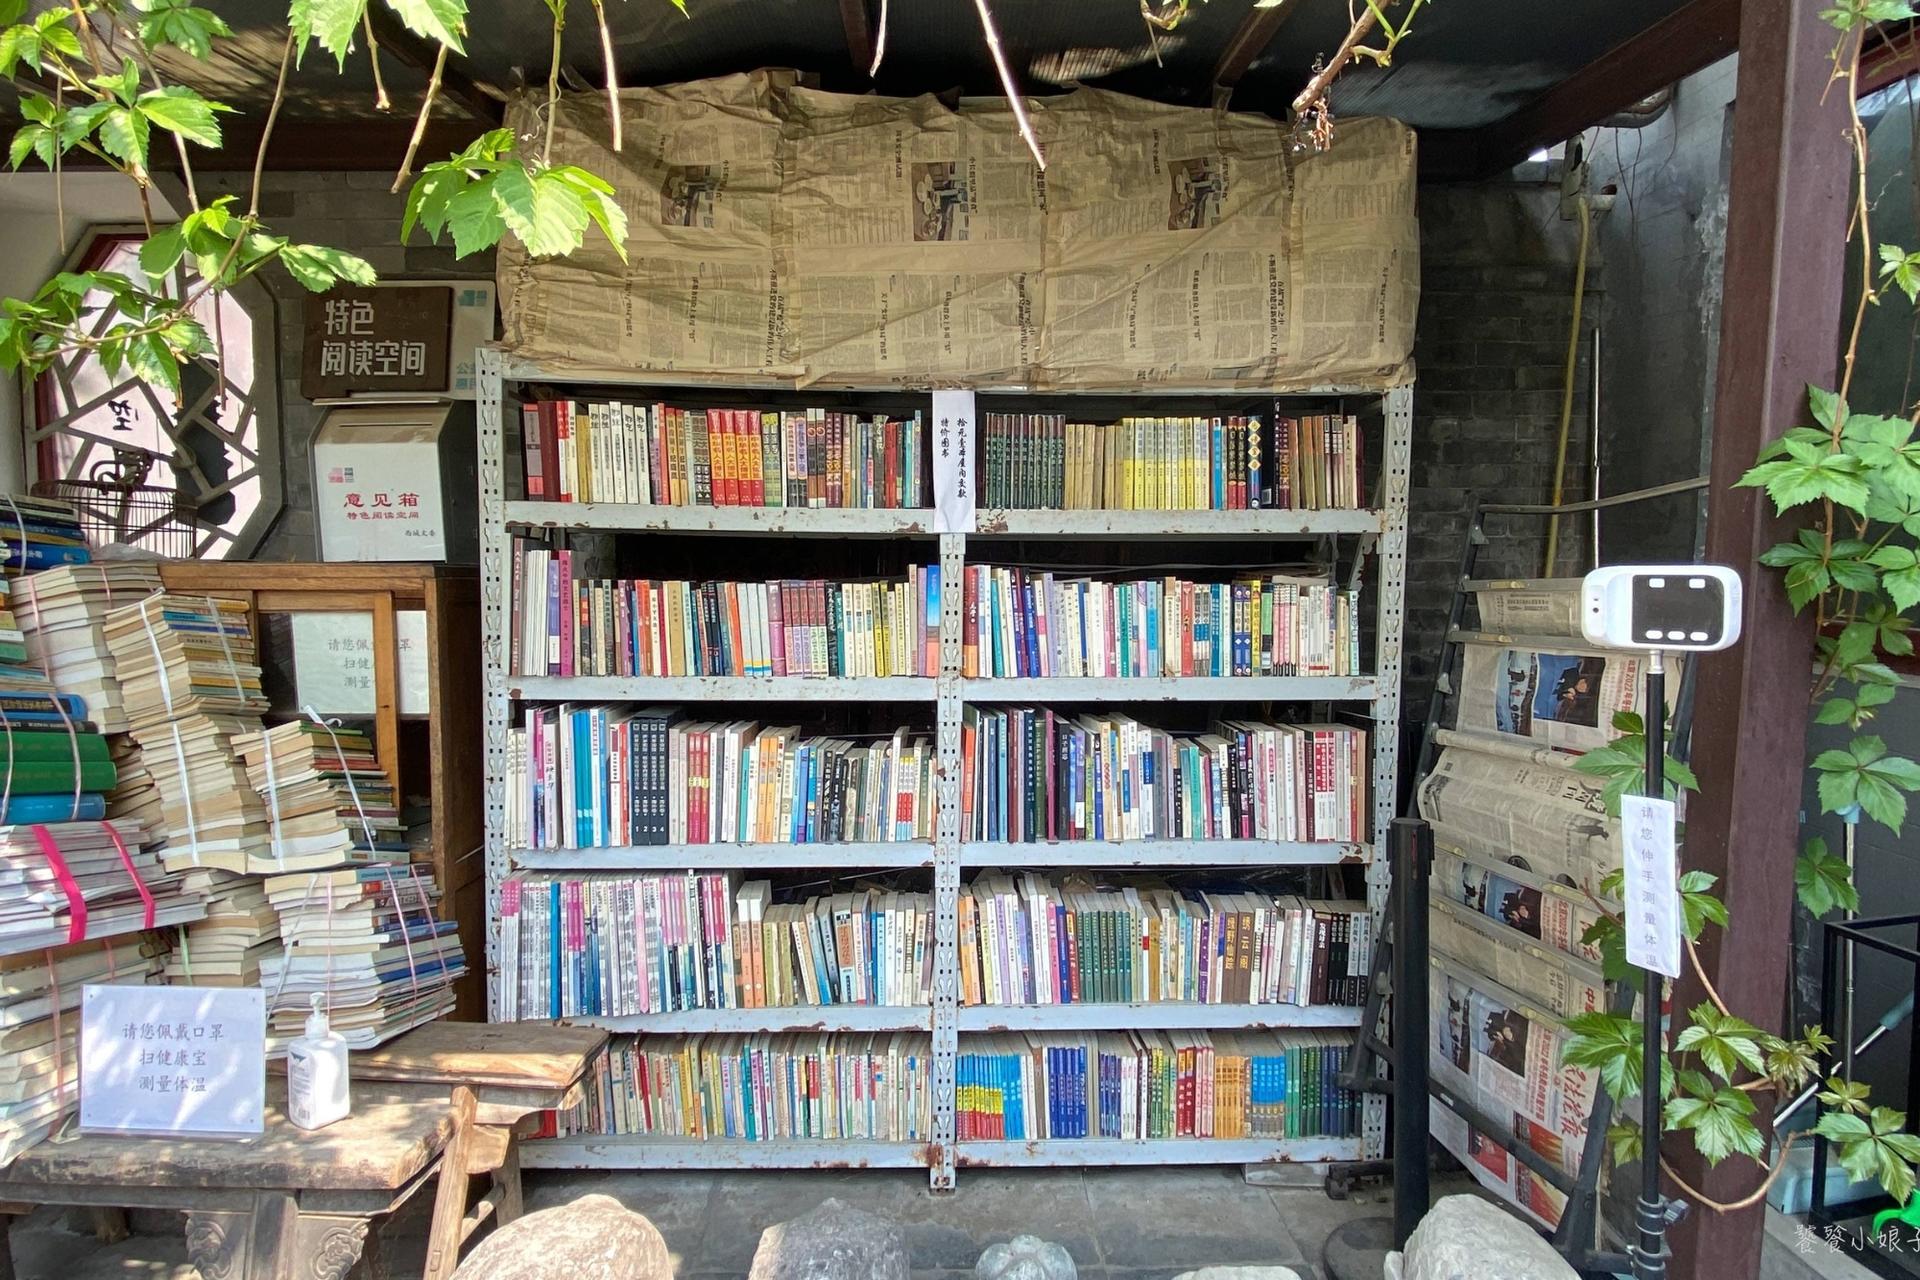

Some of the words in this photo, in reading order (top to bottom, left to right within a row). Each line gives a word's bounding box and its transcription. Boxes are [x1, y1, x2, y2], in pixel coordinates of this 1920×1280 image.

[324, 299, 375, 336] 特色
[321, 340, 426, 377] 阅读空间
[940, 418, 951, 458] 特价图书
[343, 492, 420, 509] 意见箱
[346, 511, 420, 520] 特色阅读空间
[328, 638, 374, 652] 请您佩
[344, 656, 375, 670] 扫健
[344, 676, 375, 689] 测量
[1640, 805, 1659, 967] 请您伸手测量体温
[122, 1023, 225, 1041] 请您佩戴口罩
[139, 1049, 207, 1067] 扫健康宝
[139, 1075, 207, 1093] 测量体温
